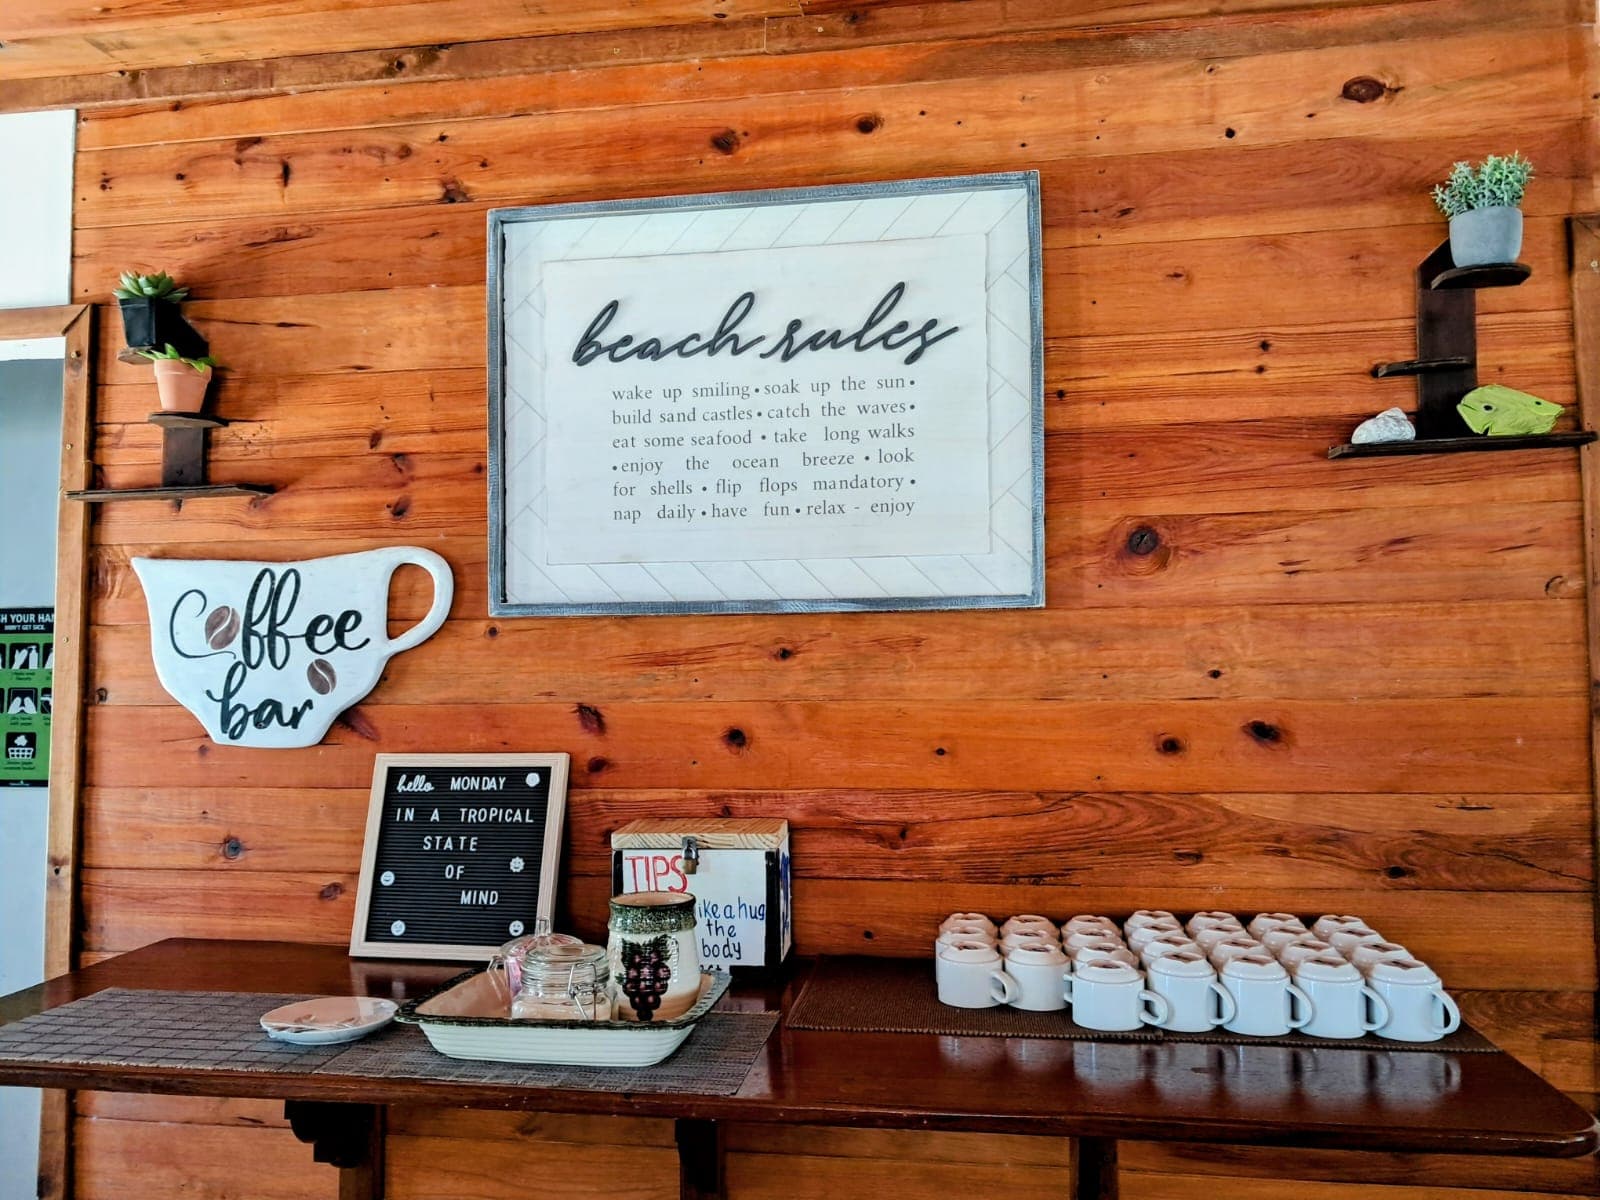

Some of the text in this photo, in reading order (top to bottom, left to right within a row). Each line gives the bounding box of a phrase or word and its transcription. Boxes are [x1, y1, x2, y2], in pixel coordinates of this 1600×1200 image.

[572, 281, 960, 368] beach rules
[612, 375, 905, 403] wake up smiling soak up the sun
[612, 401, 906, 425] build sand castles catch the waves
[612, 422, 915, 449] eat some seafood take long walks
[621, 448, 915, 476] enjoy the ocean breeze look
[613, 473, 905, 498] for shells flip flops mandatory
[613, 499, 915, 525] nap daily have fun relax enjoy
[10, 613, 36, 623] YOUR
[205, 660, 314, 741] bar
[396, 774, 506, 793] hello MONDAY
[396, 807, 534, 823] IN A TROPICAL
[422, 835, 478, 852] STATE
[444, 864, 465, 880] OF
[624, 855, 689, 893] TIPS
[460, 890, 499, 905] MIND
[737, 896, 766, 922] hug
[705, 919, 737, 938] the
[701, 938, 742, 961] body
